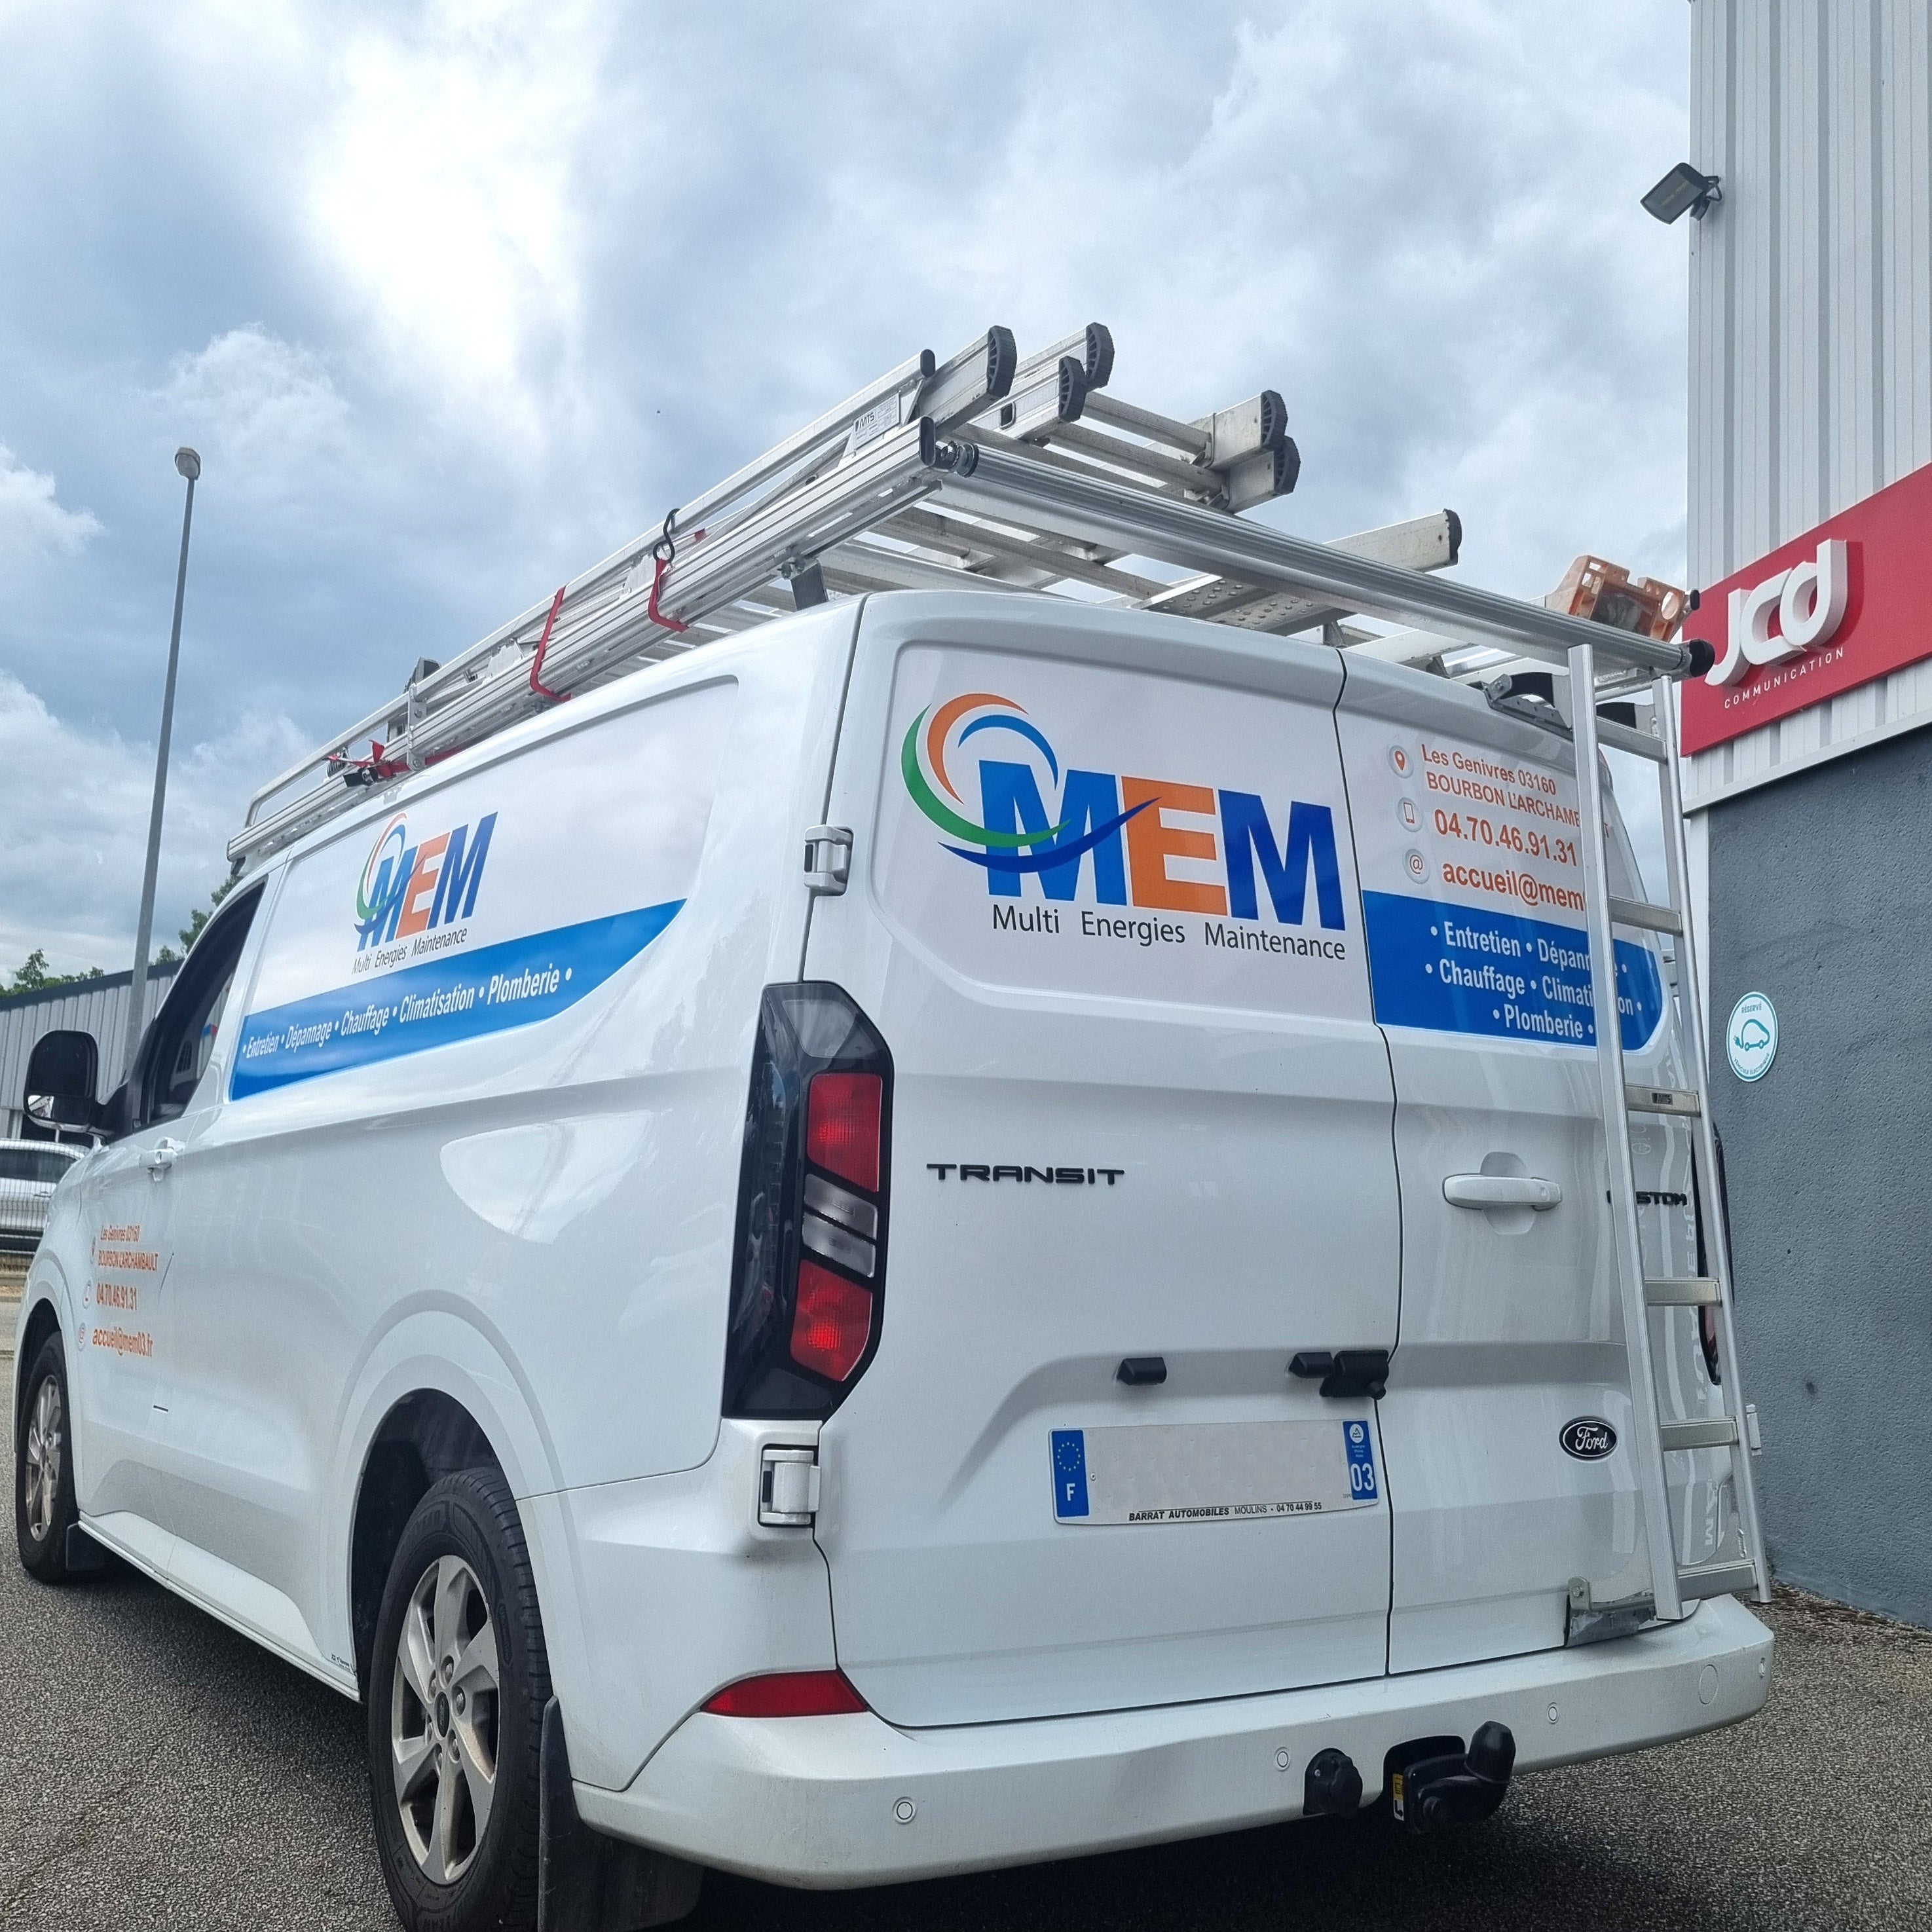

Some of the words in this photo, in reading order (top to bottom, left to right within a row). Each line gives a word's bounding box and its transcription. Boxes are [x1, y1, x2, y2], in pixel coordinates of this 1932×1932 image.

[1724, 646, 1844, 709] COMMUNICATION
[1422, 744, 1449, 766] Les
[1452, 752, 1515, 784] Genivres
[1518, 770, 1557, 796] 03160
[1426, 771, 1505, 807] BOURBON
[979, 759, 1346, 931] MEM
[1434, 809, 1577, 866] 04.70.46.91.31
[357, 811, 498, 952] MEM
[1442, 862, 1586, 912] accueil@mem
[352, 954, 373, 975] Multi
[375, 944, 407, 968] Energies
[411, 928, 467, 957] Maintenance
[992, 904, 1060, 934] Multi
[1081, 911, 1185, 946] Energies
[1204, 922, 1347, 961] Maintenance
[1443, 921, 1521, 957] Entretien
[246, 1031, 280, 1059] Entretien
[285, 1020, 333, 1053] Dépannage
[341, 1005, 390, 1036] Chauffage
[399, 986, 475, 1024] Climatisation
[487, 963, 560, 1005] Plomberie
[1440, 959, 1526, 999] Chauffage
[1542, 975, 1634, 1016] Climation
[1504, 1003, 1584, 1039] Plomberie
[926, 1163, 1125, 1185] TRANSIT
[1575, 1426, 1608, 1451] Ford
[1066, 1483, 1076, 1502] F
[1350, 1463, 1374, 1491] 03
[1128, 1511, 1164, 1521] BARRAT
[1168, 1508, 1229, 1519] AUTOMOBILES
[1235, 1505, 1267, 1515] MOULINS
[1276, 1504, 1285, 1512] 04
[1314, 1502, 1322, 1510] 55
